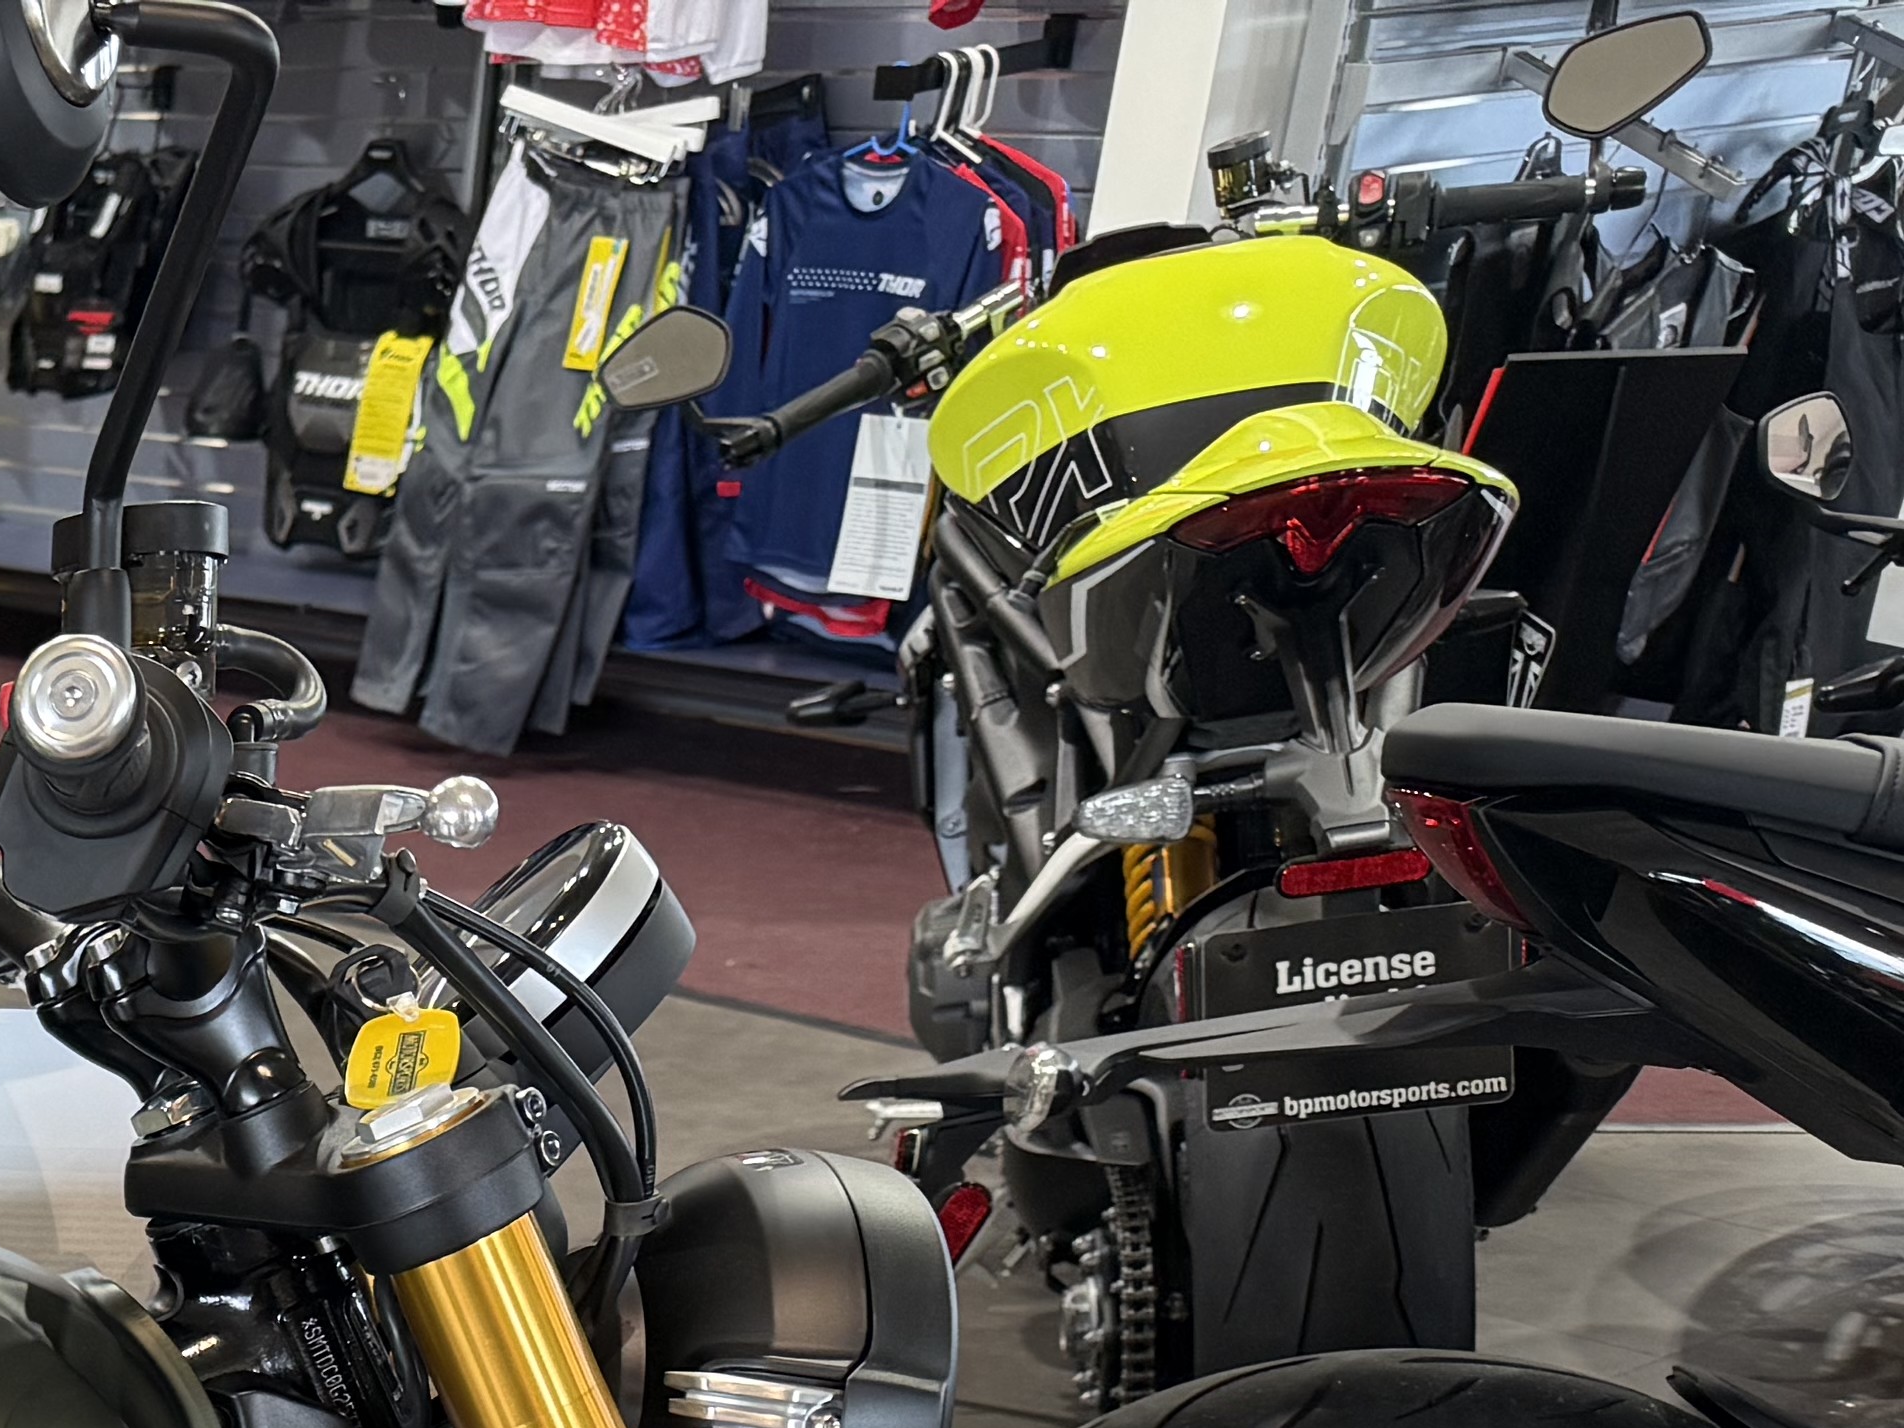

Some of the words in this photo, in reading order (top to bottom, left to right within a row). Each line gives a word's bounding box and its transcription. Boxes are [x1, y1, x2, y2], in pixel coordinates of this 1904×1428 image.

[878, 274, 926, 298] THOR
[1275, 950, 1436, 995] License
[1283, 1075, 1508, 1119] bpmotorsports.com
